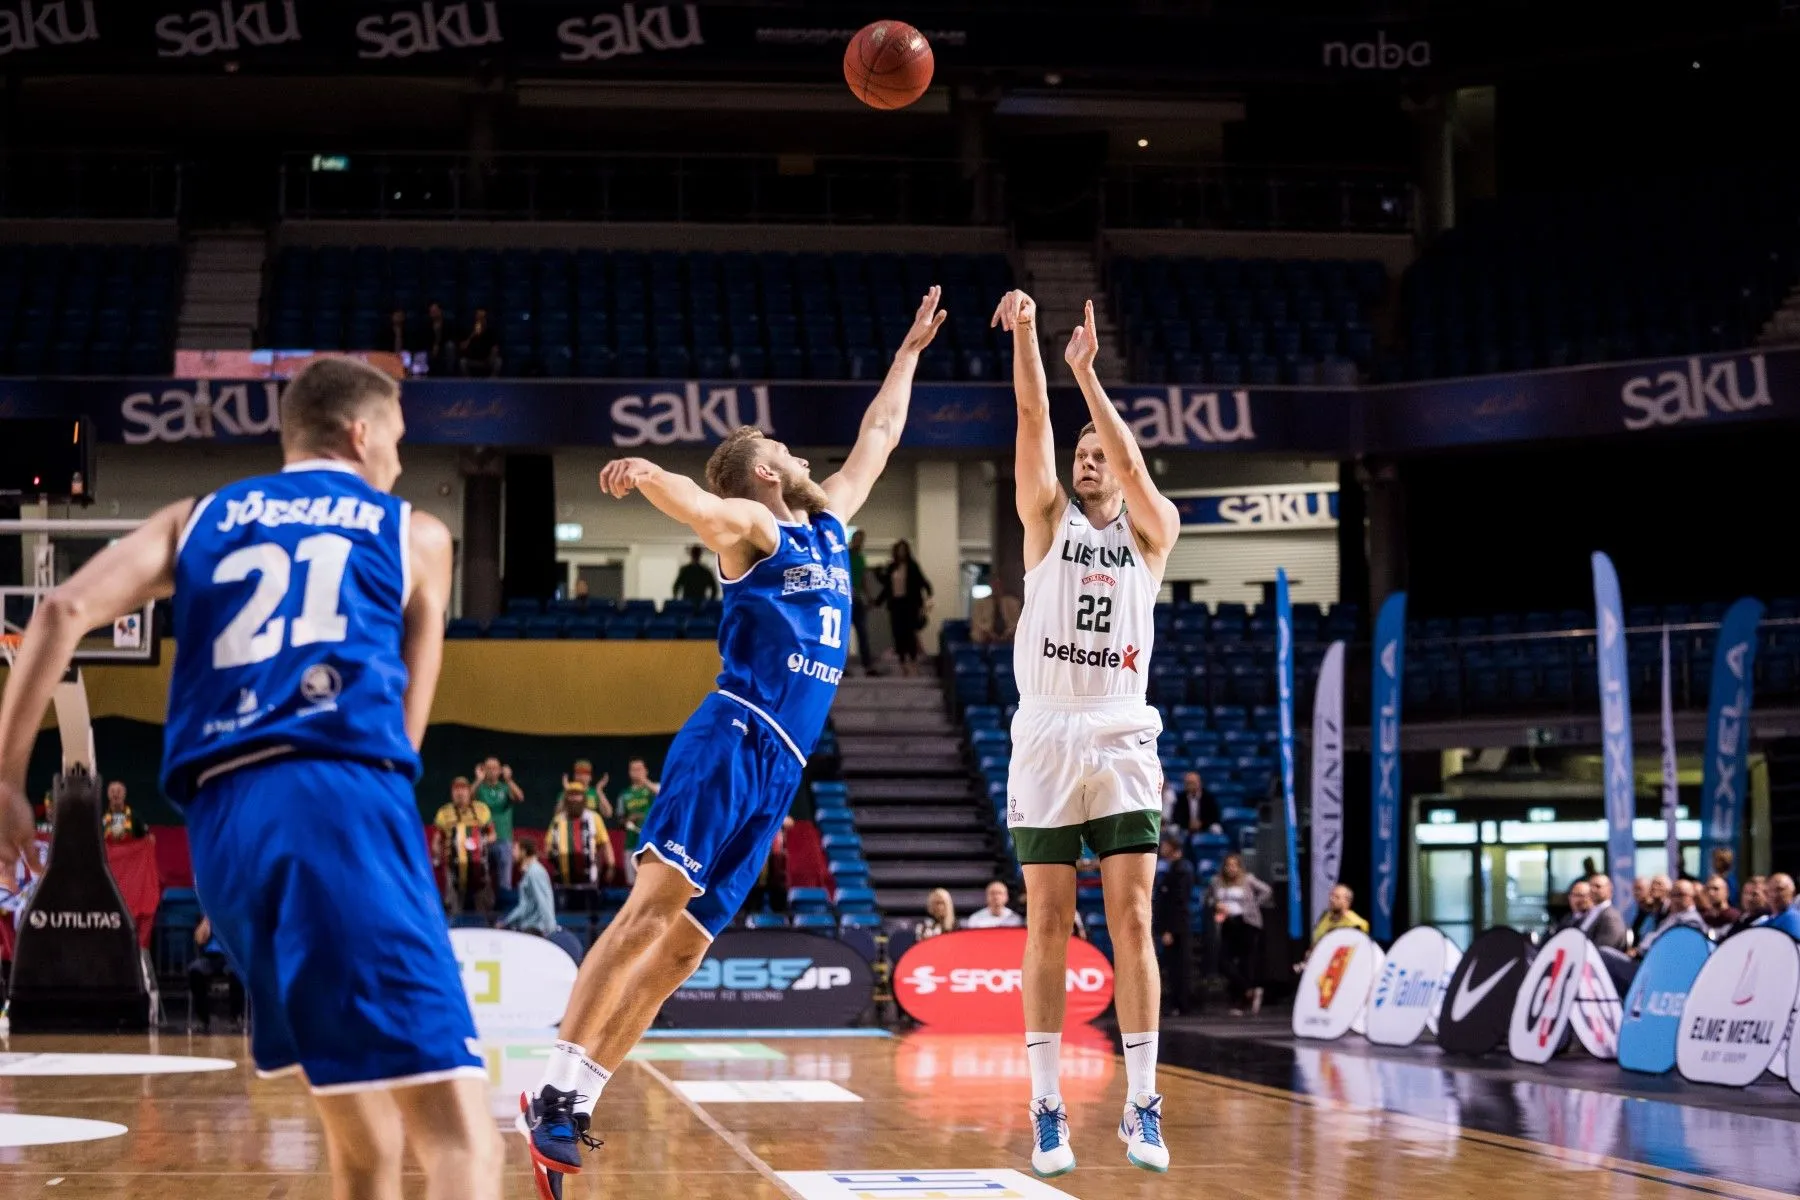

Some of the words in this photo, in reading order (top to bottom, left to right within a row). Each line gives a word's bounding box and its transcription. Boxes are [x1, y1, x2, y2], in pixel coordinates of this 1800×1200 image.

[0, 0, 99, 55] aku
[156, 0, 302, 57] saku
[356, 0, 502, 59] saku
[558, 3, 705, 61] saku
[1323, 31, 1431, 70] naba
[121, 380, 281, 444] saku
[611, 382, 773, 447] saku
[1622, 355, 1771, 430] saku
[218, 490, 387, 535] JÕESAAR
[1218, 492, 1331, 526] saku
[212, 532, 353, 670] 21
[819, 605, 842, 649] 11
[1076, 594, 1112, 633] 22
[1043, 638, 1120, 668] betsafe
[1375, 638, 1398, 917] ALEXELA
[50, 911, 121, 929] UTILITAS
[950, 967, 1105, 994] SPORND
